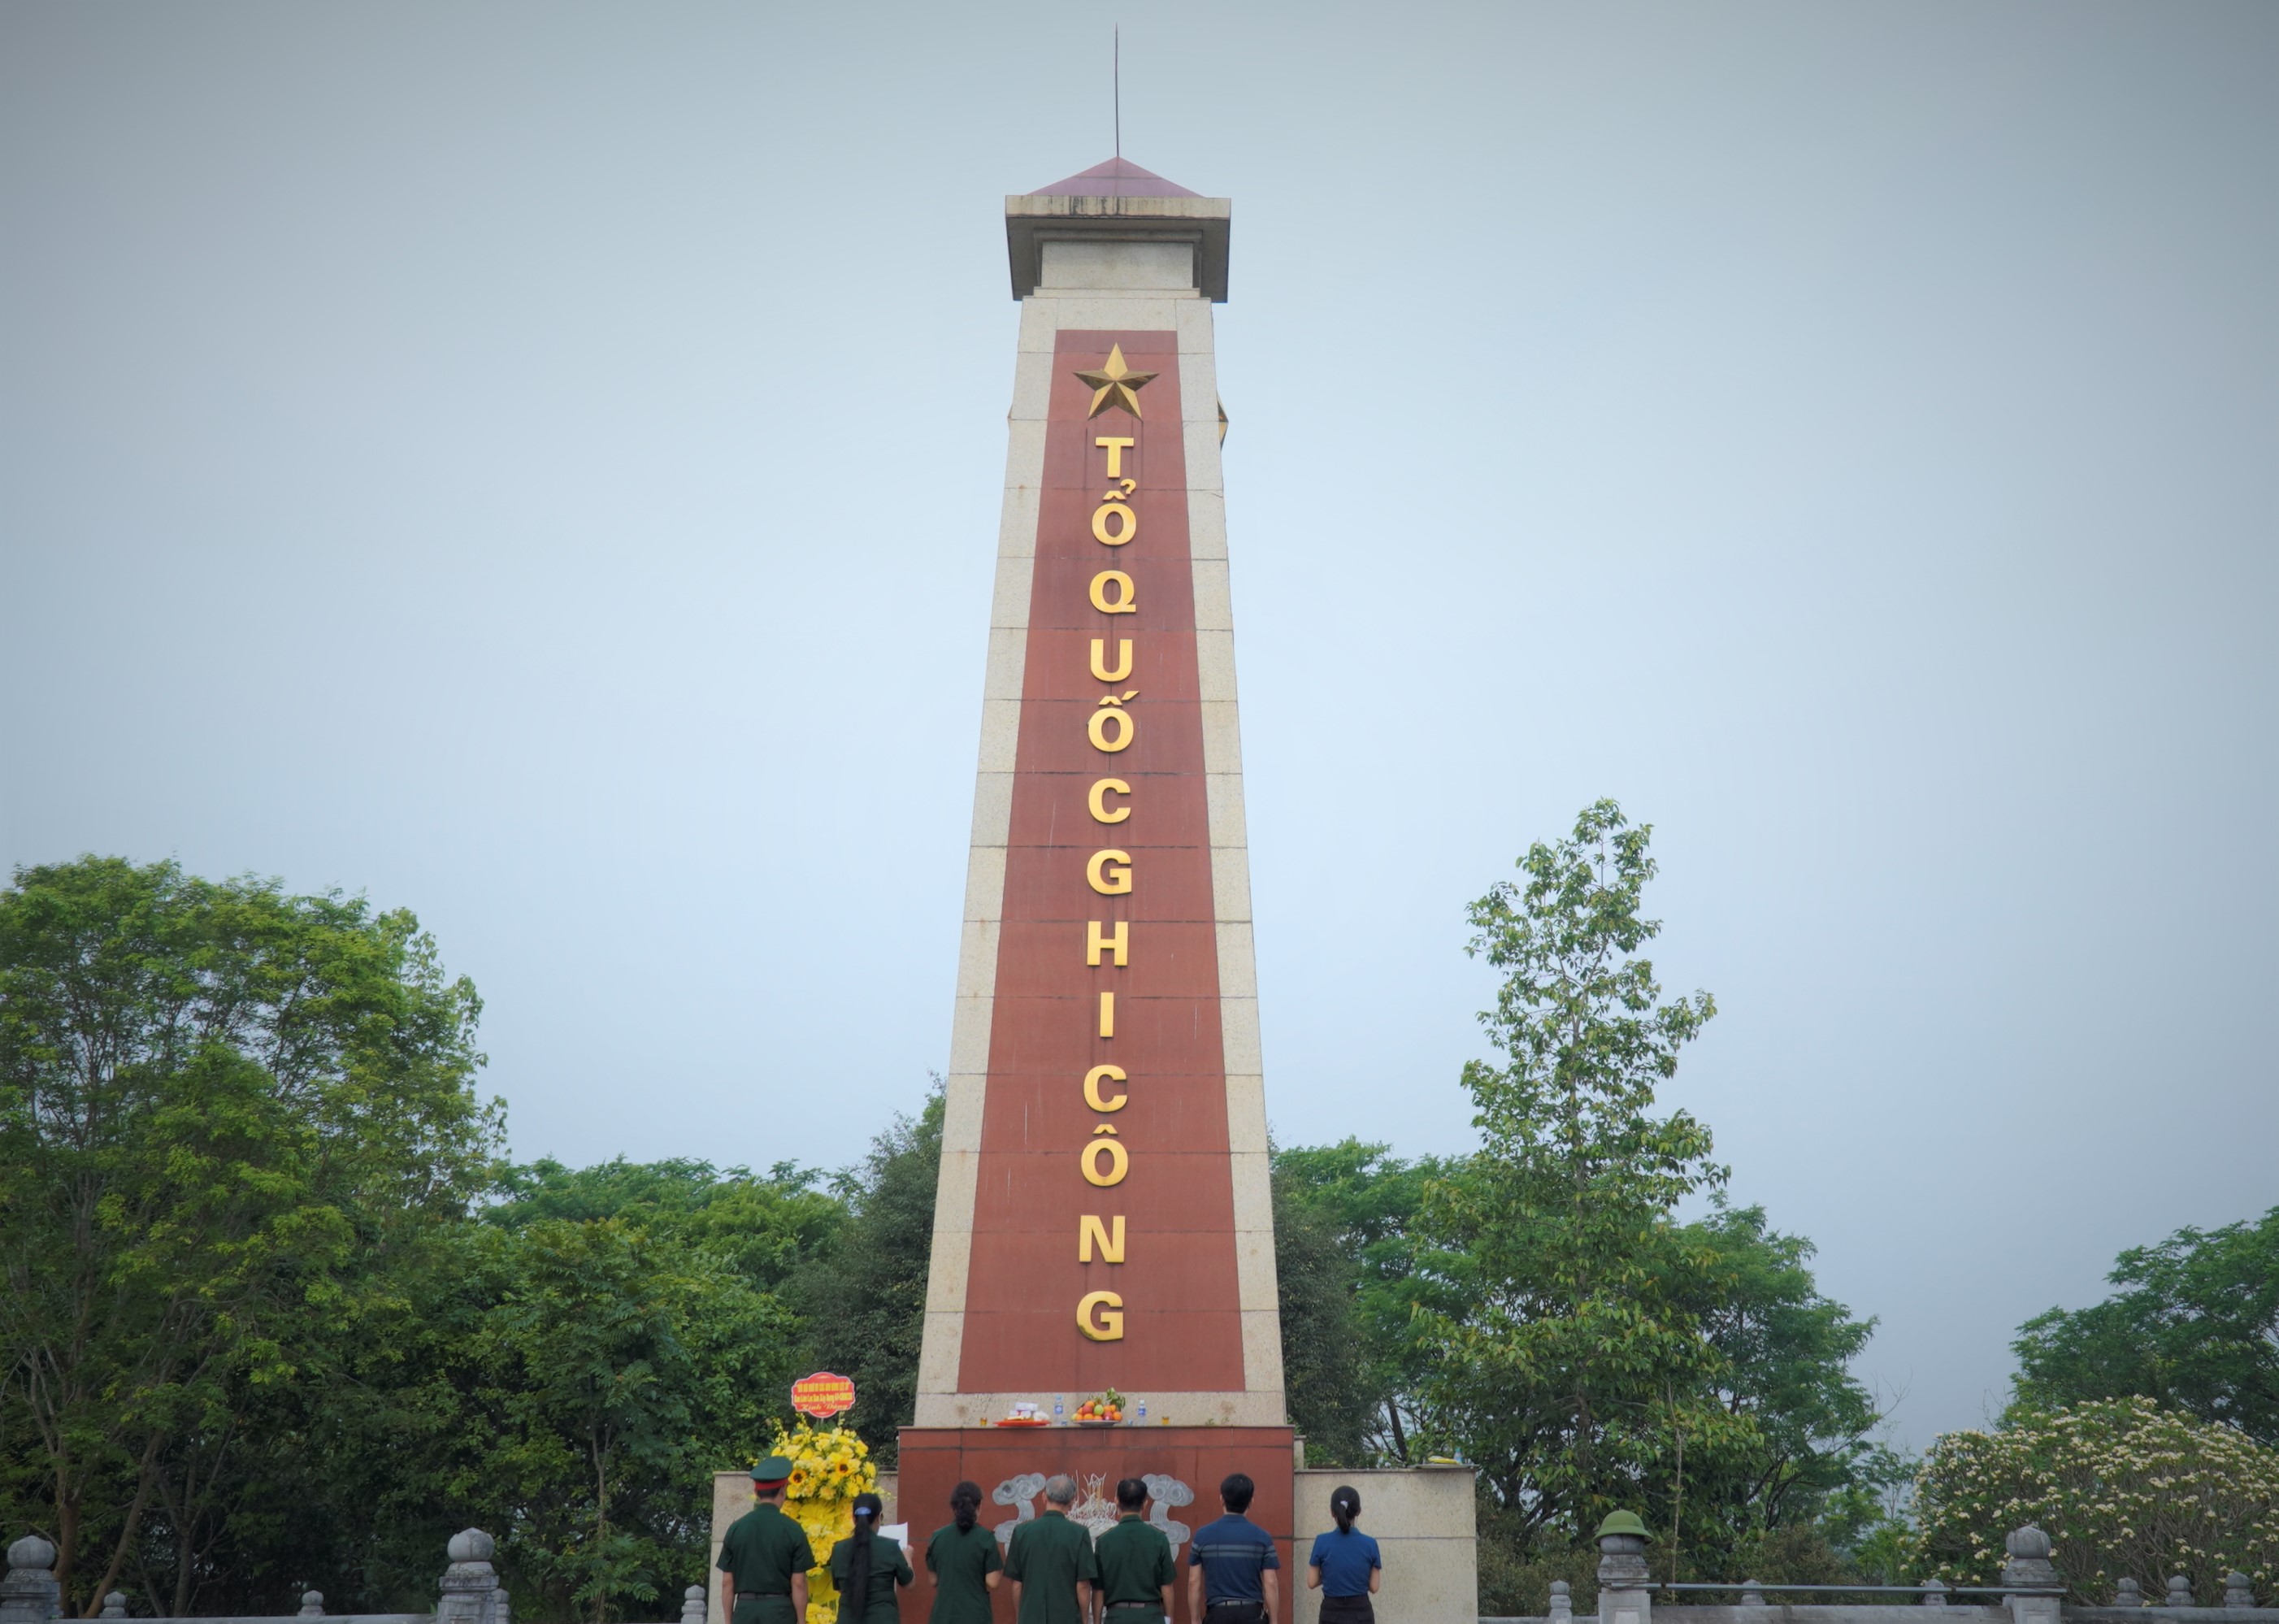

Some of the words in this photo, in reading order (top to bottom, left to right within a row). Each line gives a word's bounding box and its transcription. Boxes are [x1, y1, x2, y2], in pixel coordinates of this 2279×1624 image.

[1091, 436, 1138, 546] TỔ
[1086, 570, 1140, 824] QUỐC
[1085, 849, 1133, 1039] GHI
[1074, 1063, 1130, 1342] CÔNG
